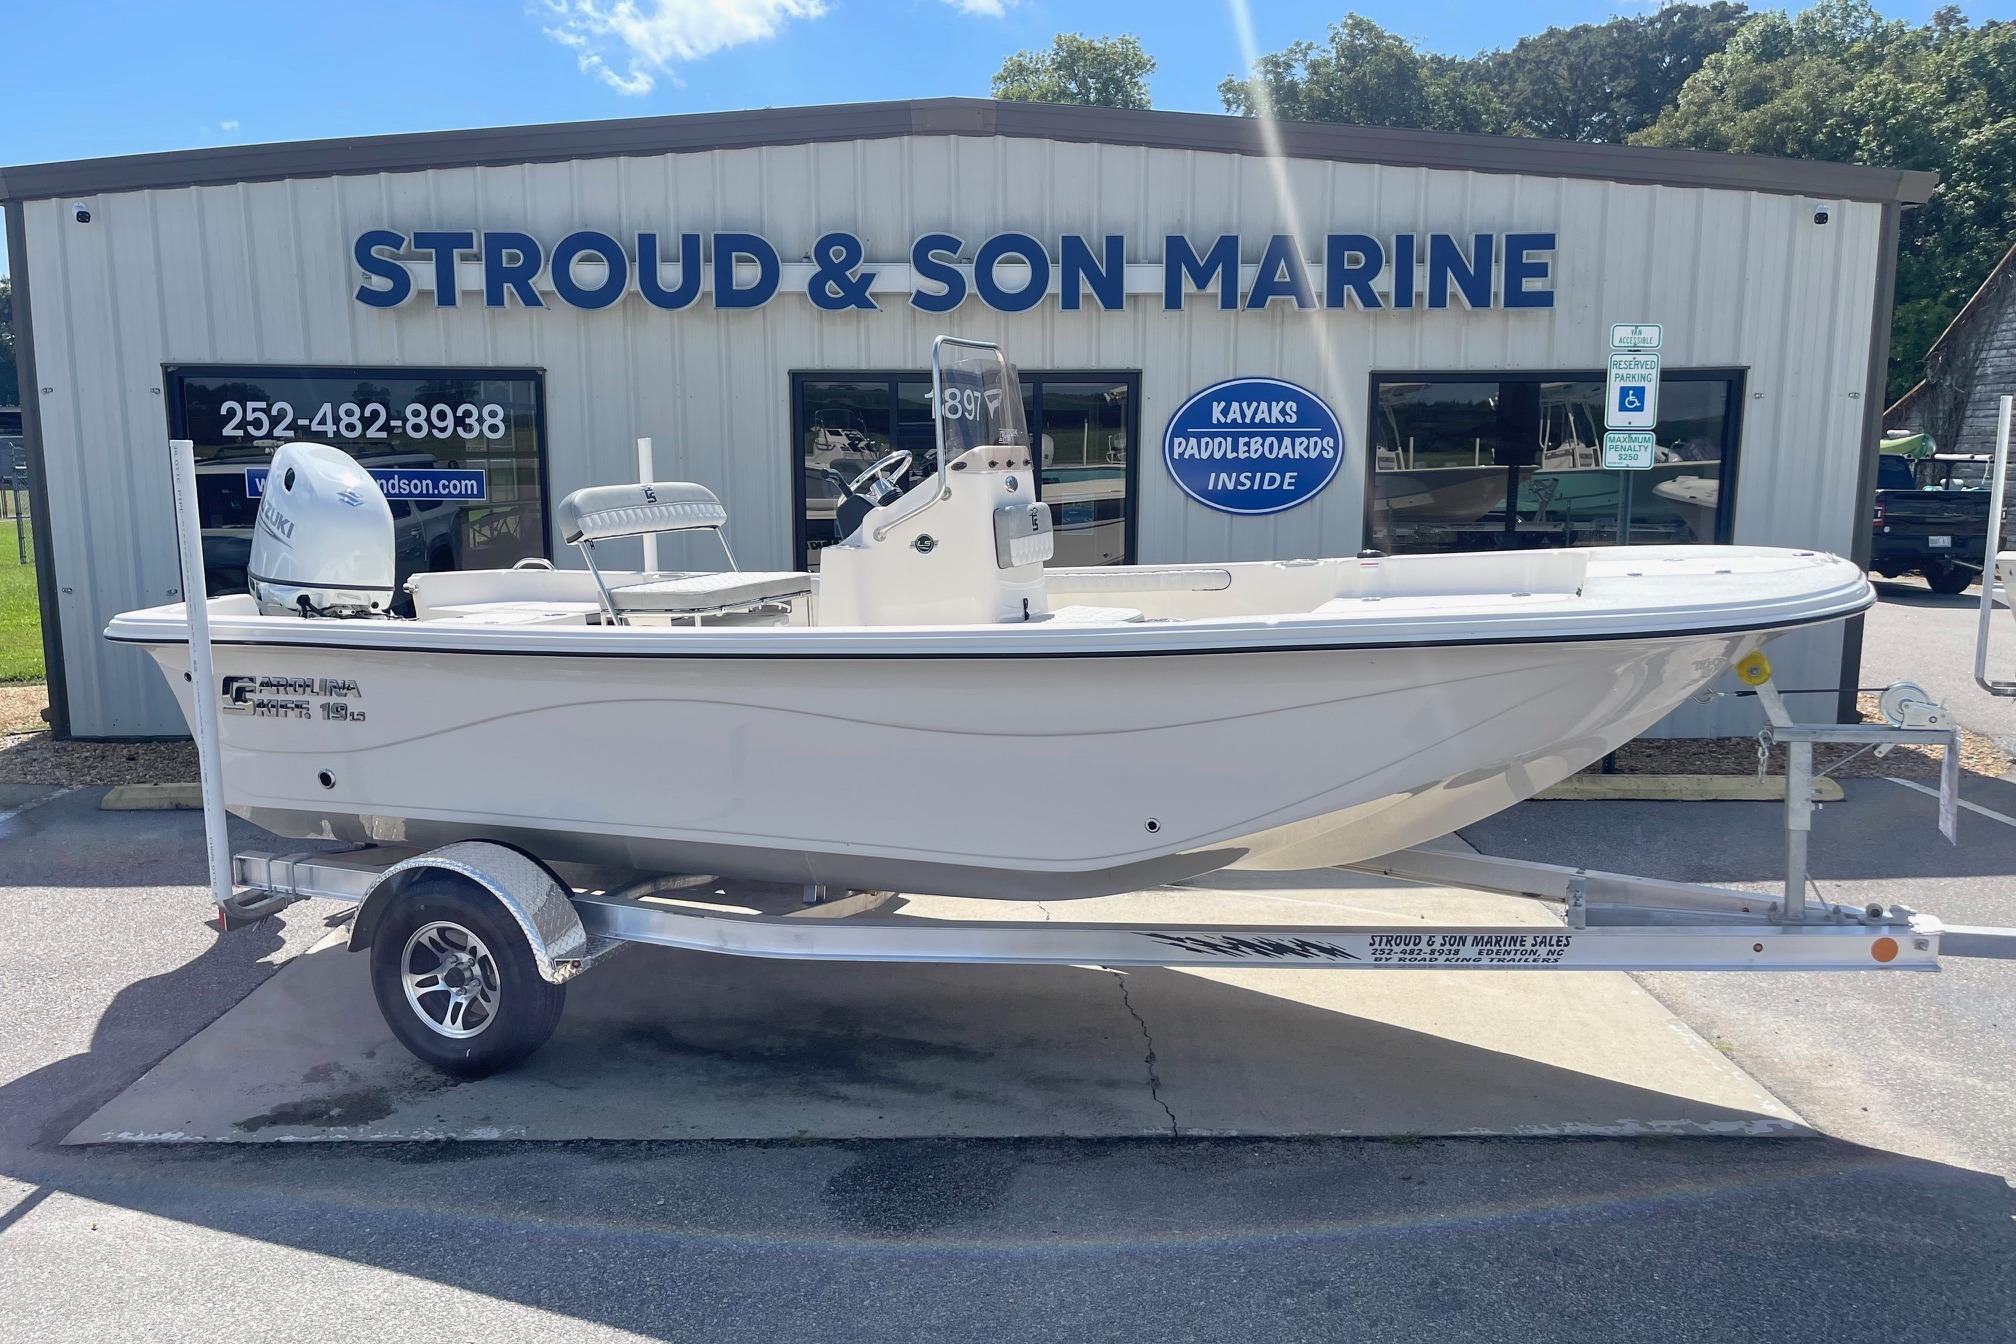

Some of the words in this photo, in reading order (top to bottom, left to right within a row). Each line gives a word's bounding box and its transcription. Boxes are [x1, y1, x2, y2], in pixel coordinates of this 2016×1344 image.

[353, 229, 782, 311] STROUD
[806, 230, 882, 311] &
[909, 231, 1126, 312] SON
[1163, 232, 1557, 311] MARINE
[1618, 336, 1653, 345] ACCESSIBLE
[1612, 360, 1656, 370] RESERVED
[1615, 373, 1652, 383] PARKING
[1212, 401, 1297, 424] KAYAKS
[220, 400, 506, 439] 252-482-8938
[1608, 436, 1651, 444] MAXIMUM
[1173, 436, 1334, 459] PADDLEBOARDS
[1618, 453, 1639, 461] $250
[1208, 472, 1298, 490] INSIDE
[1369, 935, 1422, 947] STROUD
[1426, 935, 1435, 947] &
[1440, 935, 1468, 947] SON
[1471, 936, 1526, 948] MARINE
[1530, 936, 1572, 948] SALES
[1477, 949, 1541, 957] EDENTON,
